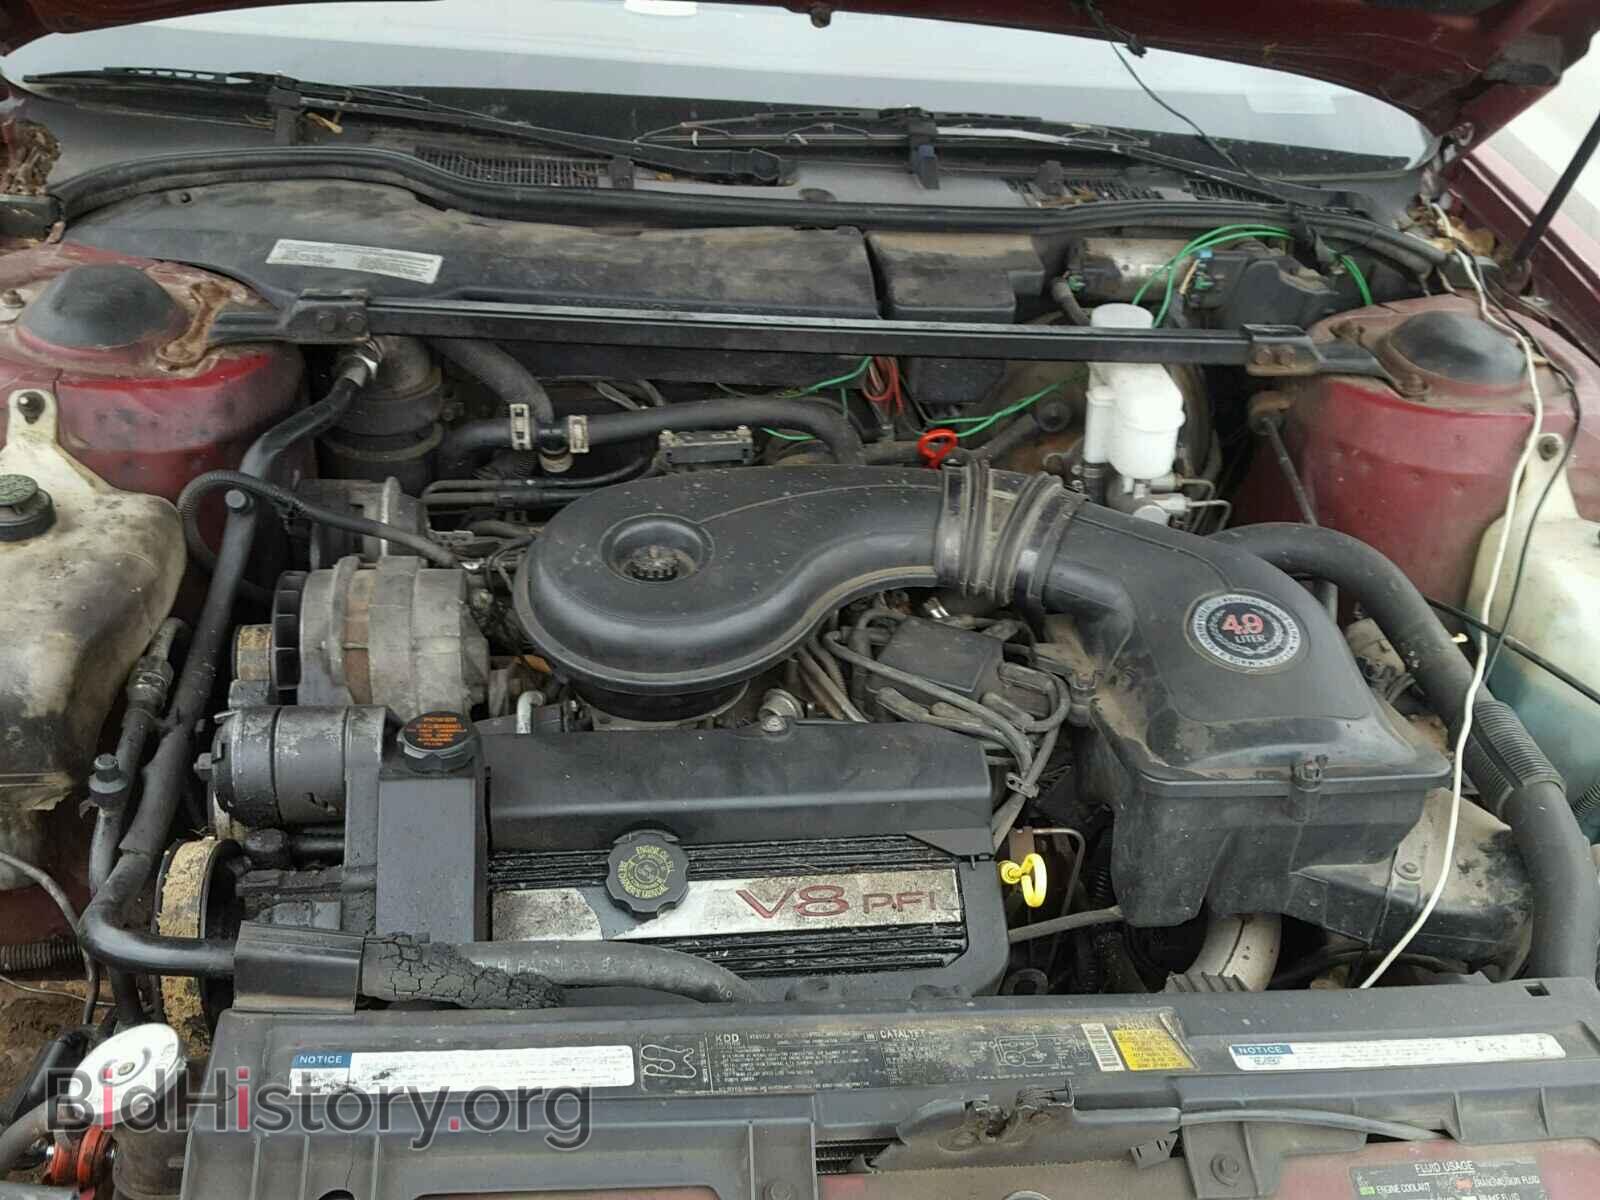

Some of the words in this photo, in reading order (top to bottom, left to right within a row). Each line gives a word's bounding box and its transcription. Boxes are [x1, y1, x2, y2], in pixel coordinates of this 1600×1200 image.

[736, 885, 850, 919] V8
[863, 891, 936, 915] PFI
[1239, 1046, 1282, 1055] NOTICE
[300, 1055, 343, 1065] NOTICE
[1415, 1162, 1440, 1174] FLUID
[1442, 1160, 1474, 1172] USAGE
